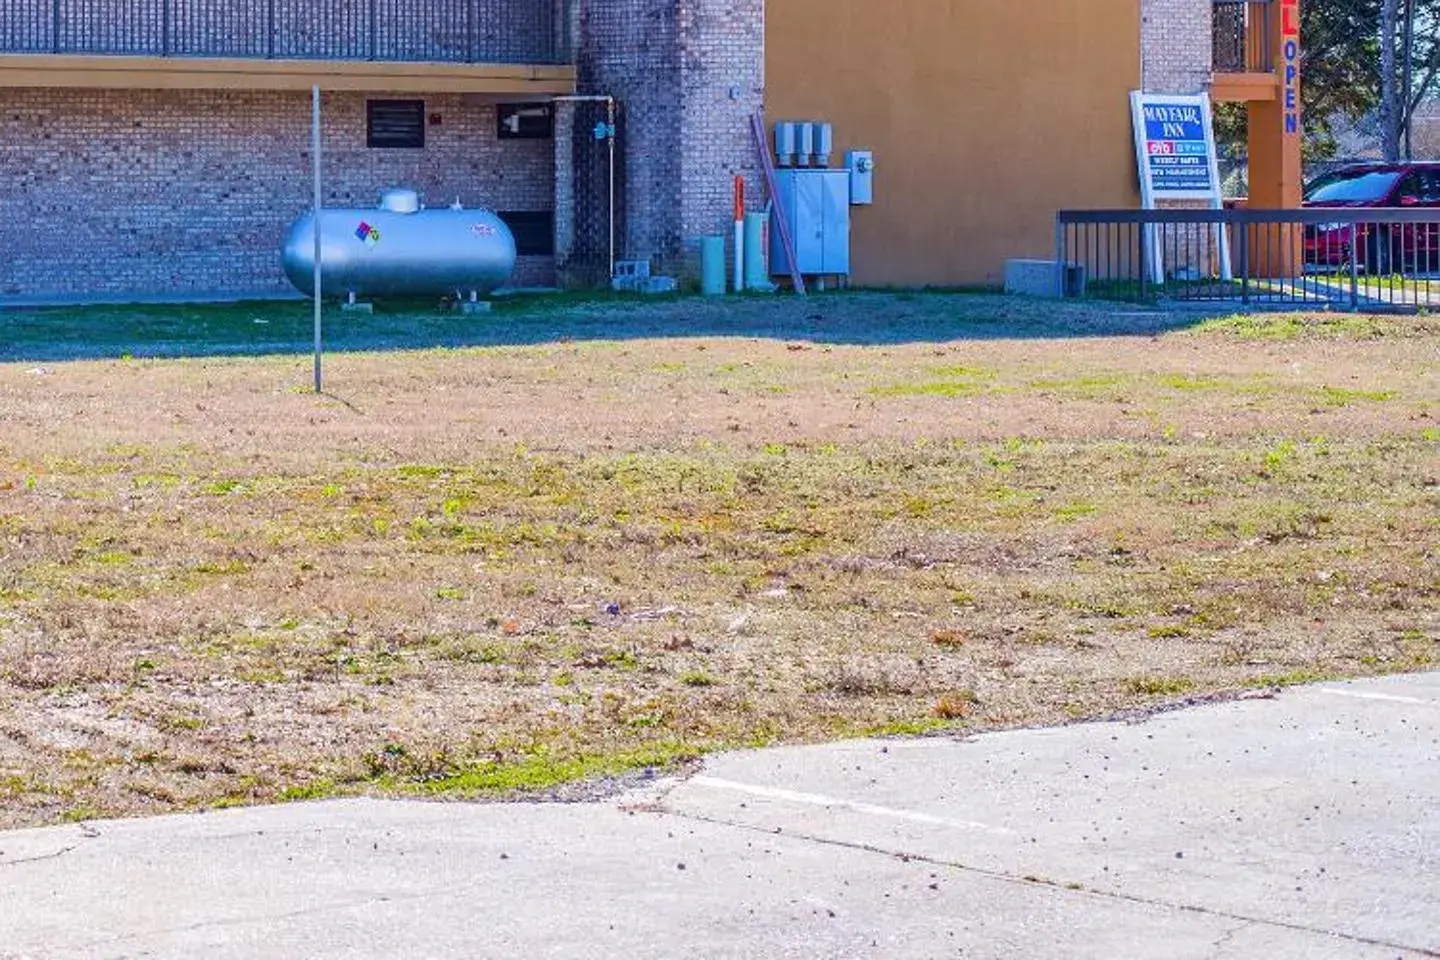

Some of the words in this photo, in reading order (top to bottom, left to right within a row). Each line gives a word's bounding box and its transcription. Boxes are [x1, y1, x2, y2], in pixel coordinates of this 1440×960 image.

[1284, 40, 1298, 134] OPEN
[1144, 106, 1200, 126] MAYFAIR
[1162, 122, 1185, 137] INN
